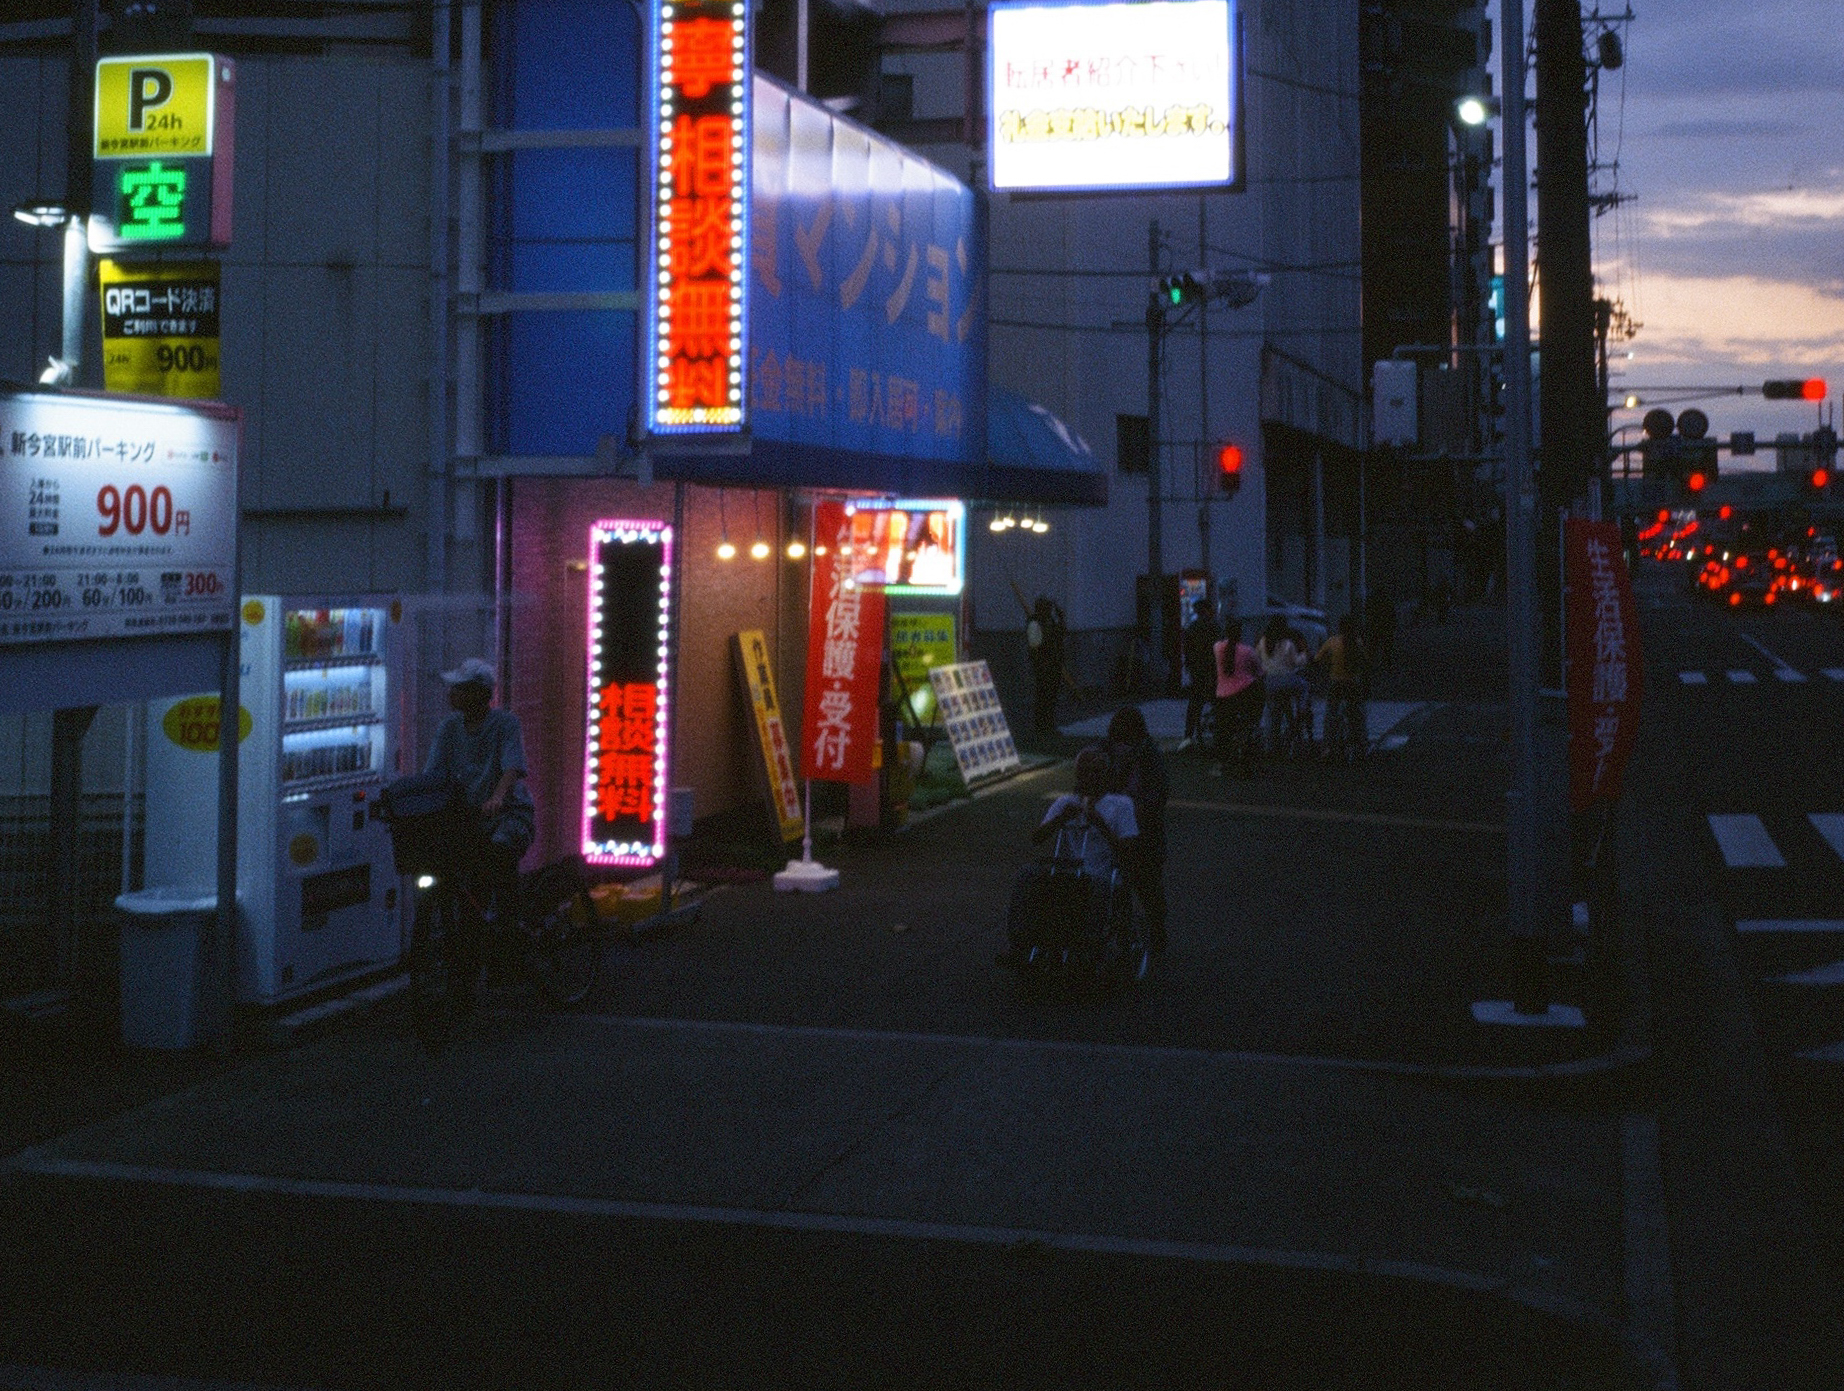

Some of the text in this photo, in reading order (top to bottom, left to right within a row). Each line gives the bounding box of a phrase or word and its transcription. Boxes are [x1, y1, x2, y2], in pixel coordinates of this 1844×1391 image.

[129, 68, 173, 132] P
[147, 113, 182, 131] 24h
[120, 161, 186, 240] 空
[106, 287, 215, 316] QRコード決済
[11, 430, 156, 462] 新今宮駅前パーキング
[599, 682, 657, 823] 相談無料
